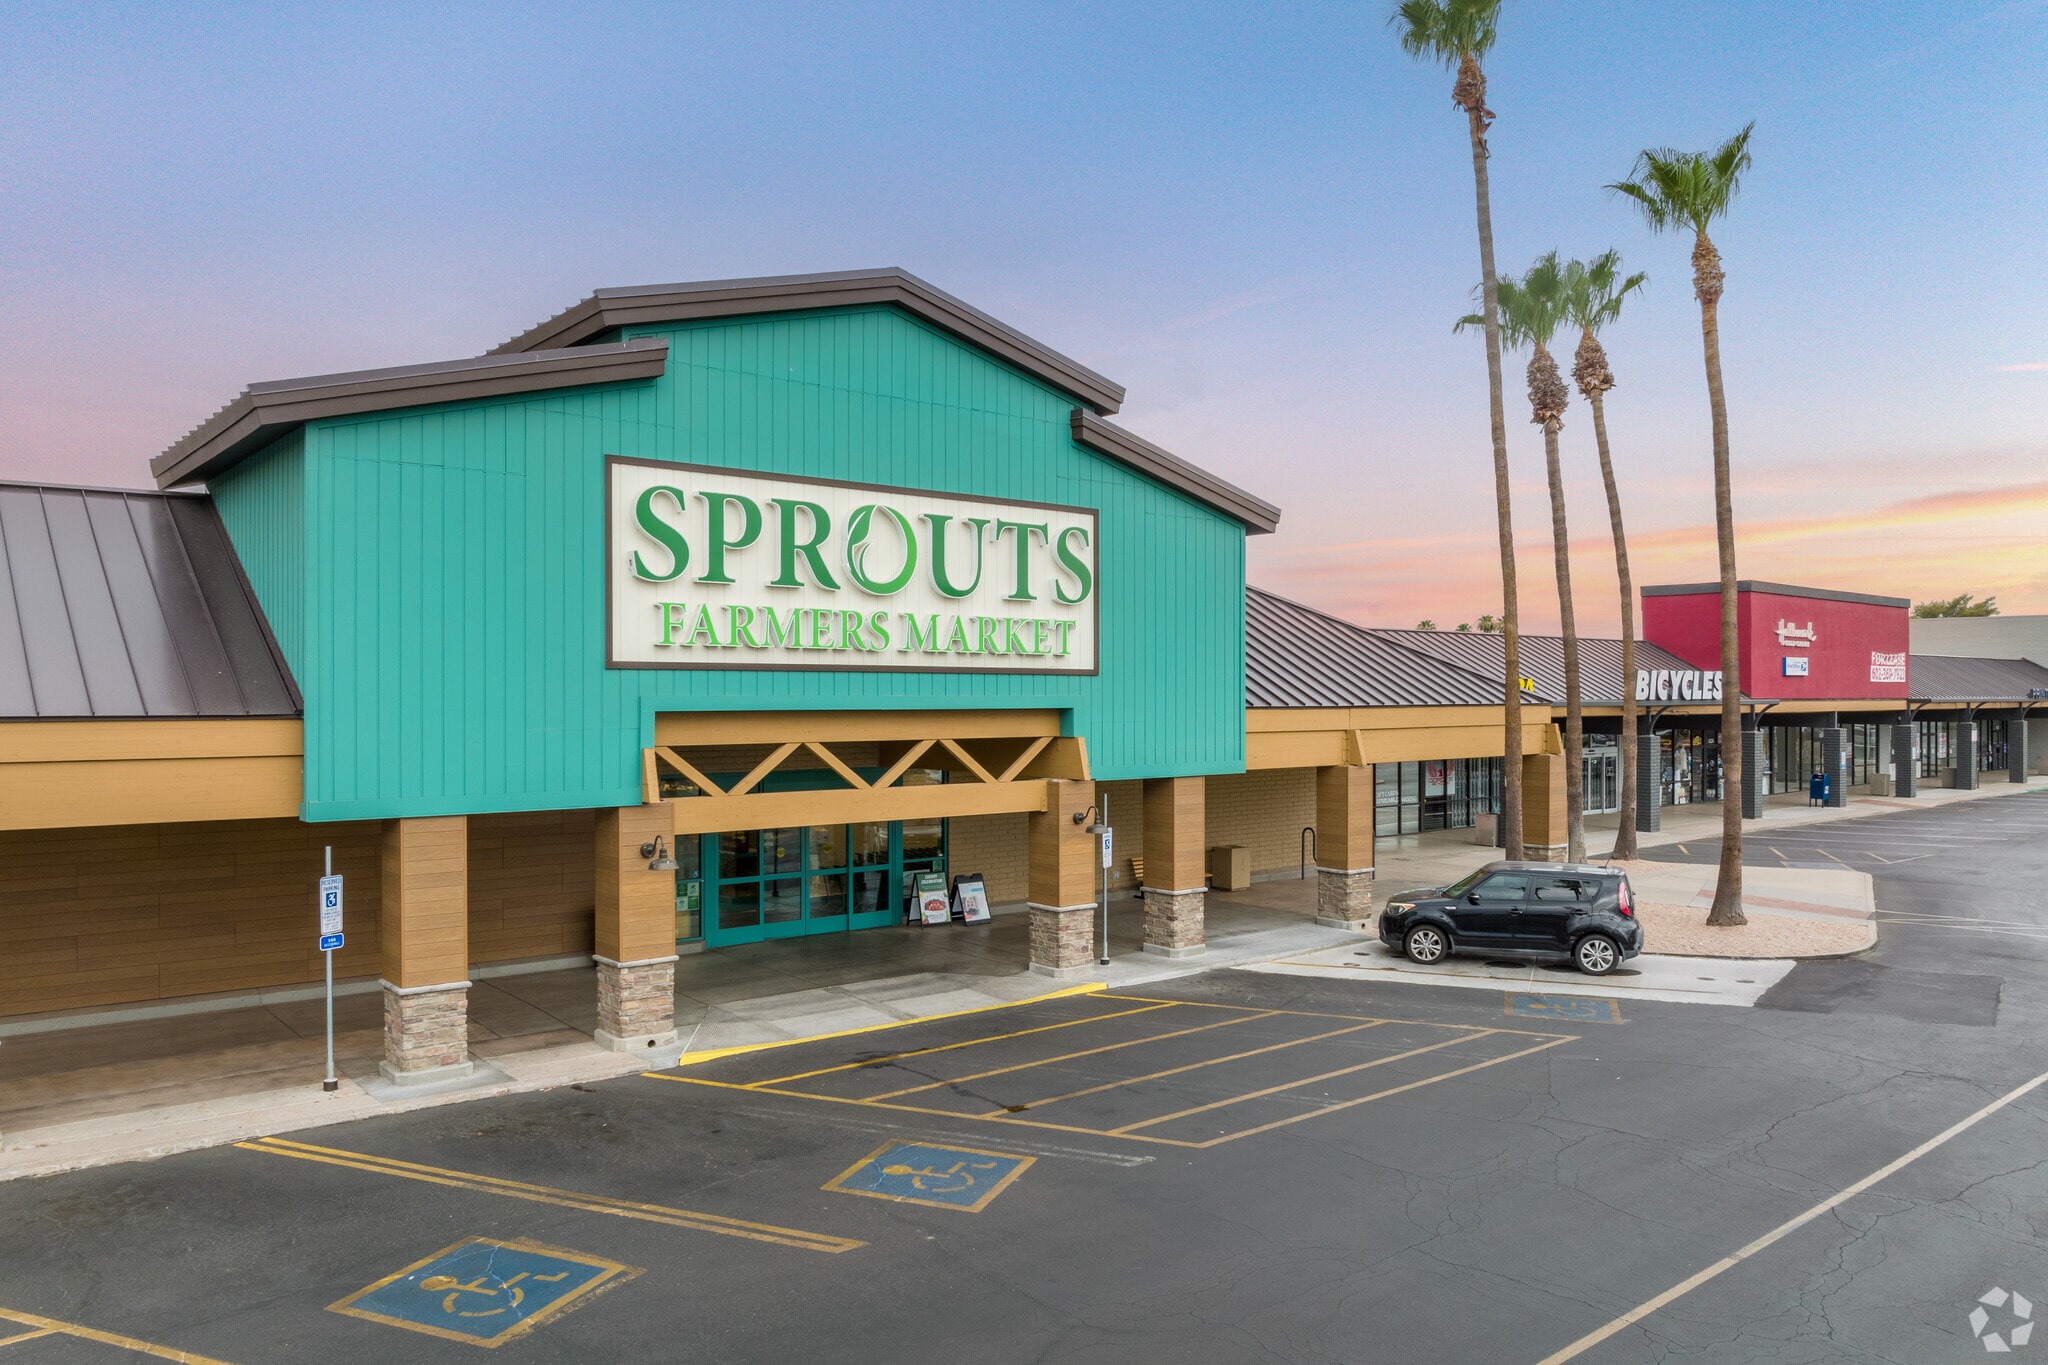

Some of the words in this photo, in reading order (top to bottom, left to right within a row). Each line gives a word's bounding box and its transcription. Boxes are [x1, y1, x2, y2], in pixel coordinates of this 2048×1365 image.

[628, 485, 1093, 605] SPROUTS
[655, 602, 890, 652] FARMERS
[903, 612, 1077, 656] MARKET
[1635, 669, 1723, 700] BICYCLES
